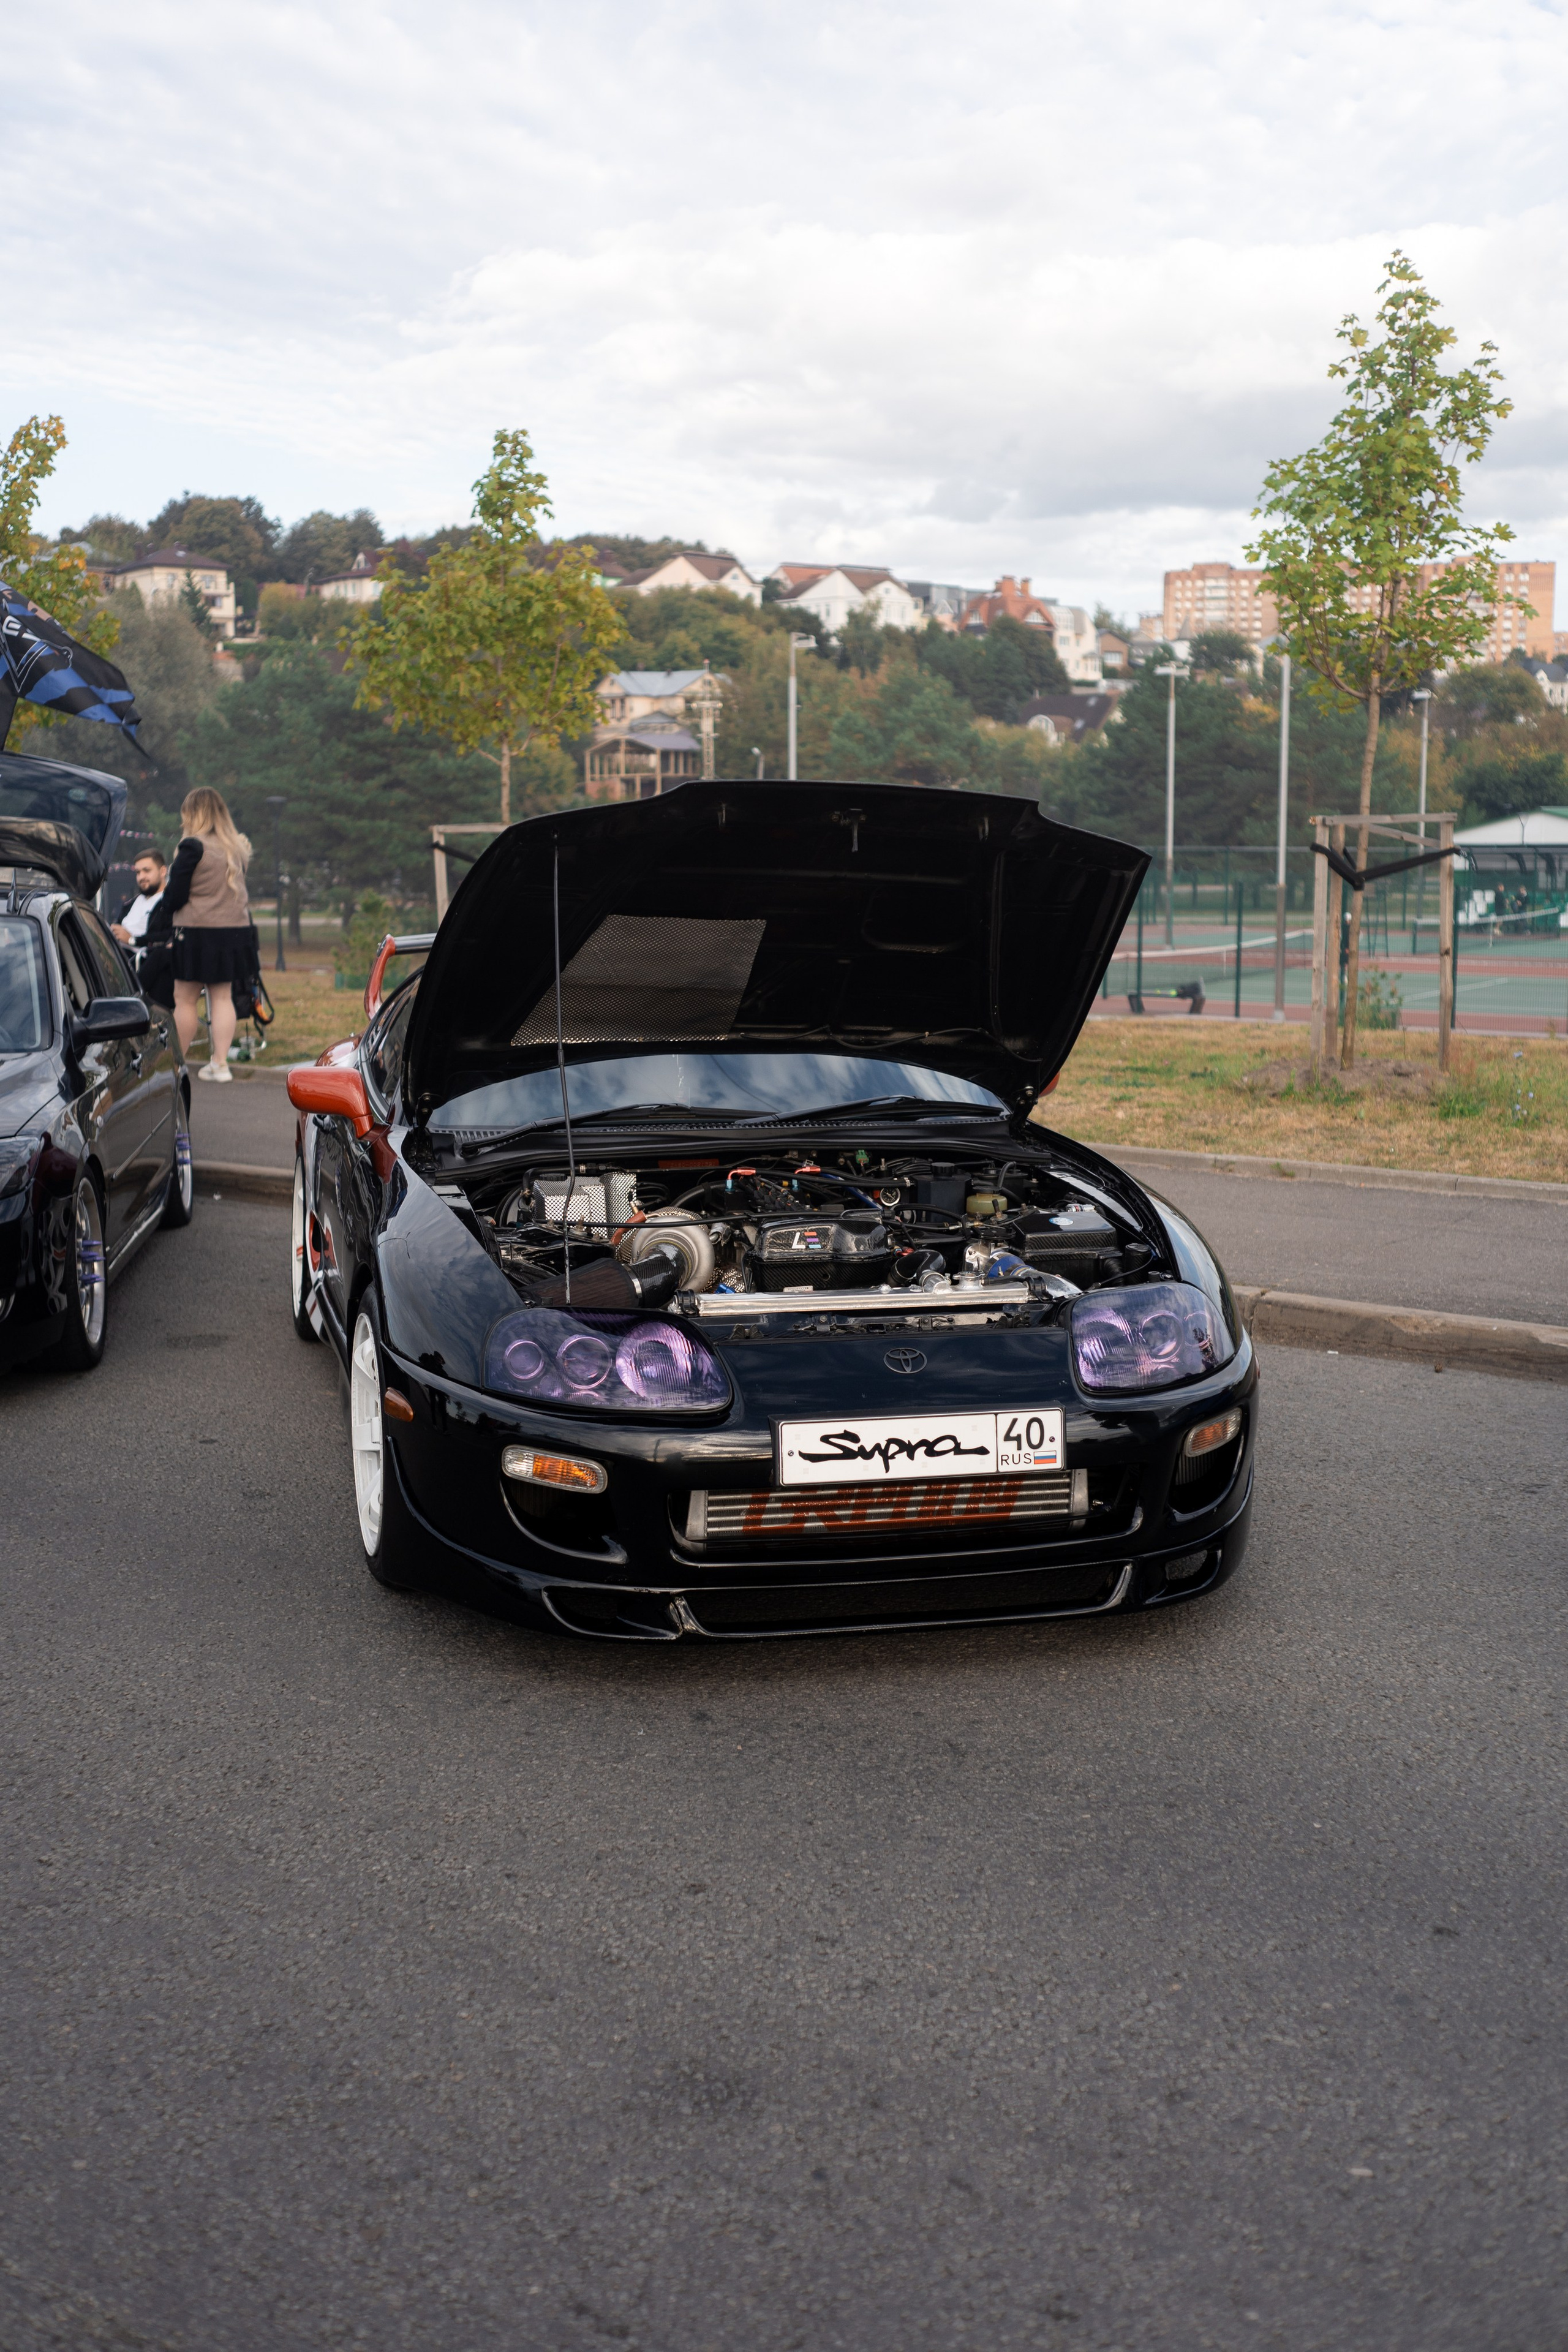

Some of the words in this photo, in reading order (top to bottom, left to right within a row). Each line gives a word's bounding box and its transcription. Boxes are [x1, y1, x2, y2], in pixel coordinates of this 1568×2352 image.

[1003, 1417, 1044, 1450] 40
[798, 1430, 990, 1473] Supra
[1001, 1453, 1031, 1466] RUS
